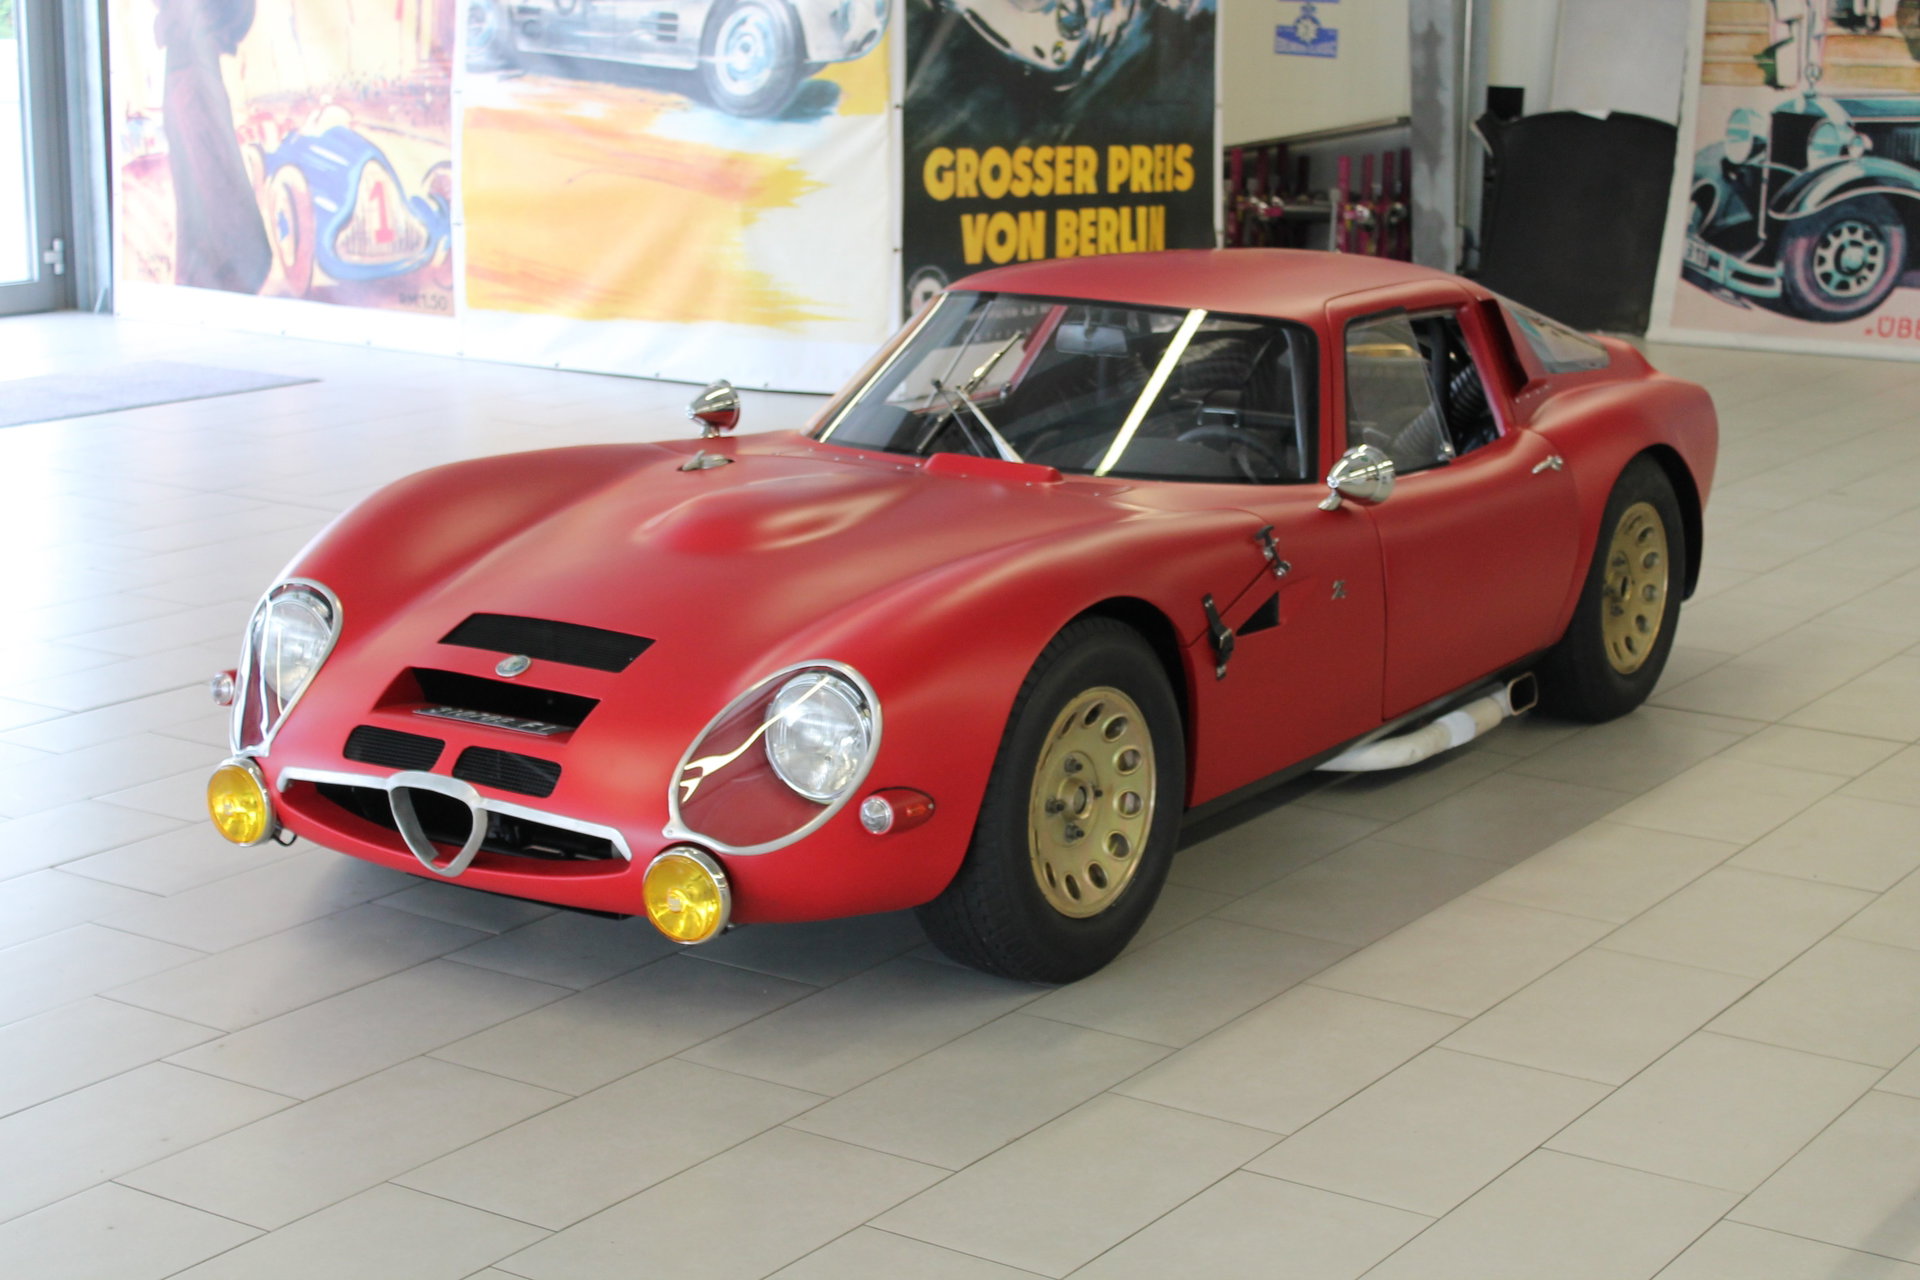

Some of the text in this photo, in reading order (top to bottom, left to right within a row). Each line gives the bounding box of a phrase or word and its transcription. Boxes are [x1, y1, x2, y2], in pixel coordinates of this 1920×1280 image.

[923, 144, 1195, 201] GROSSER PREIS
[369, 181, 396, 243] 1
[960, 205, 1165, 265] VON BERLIN
